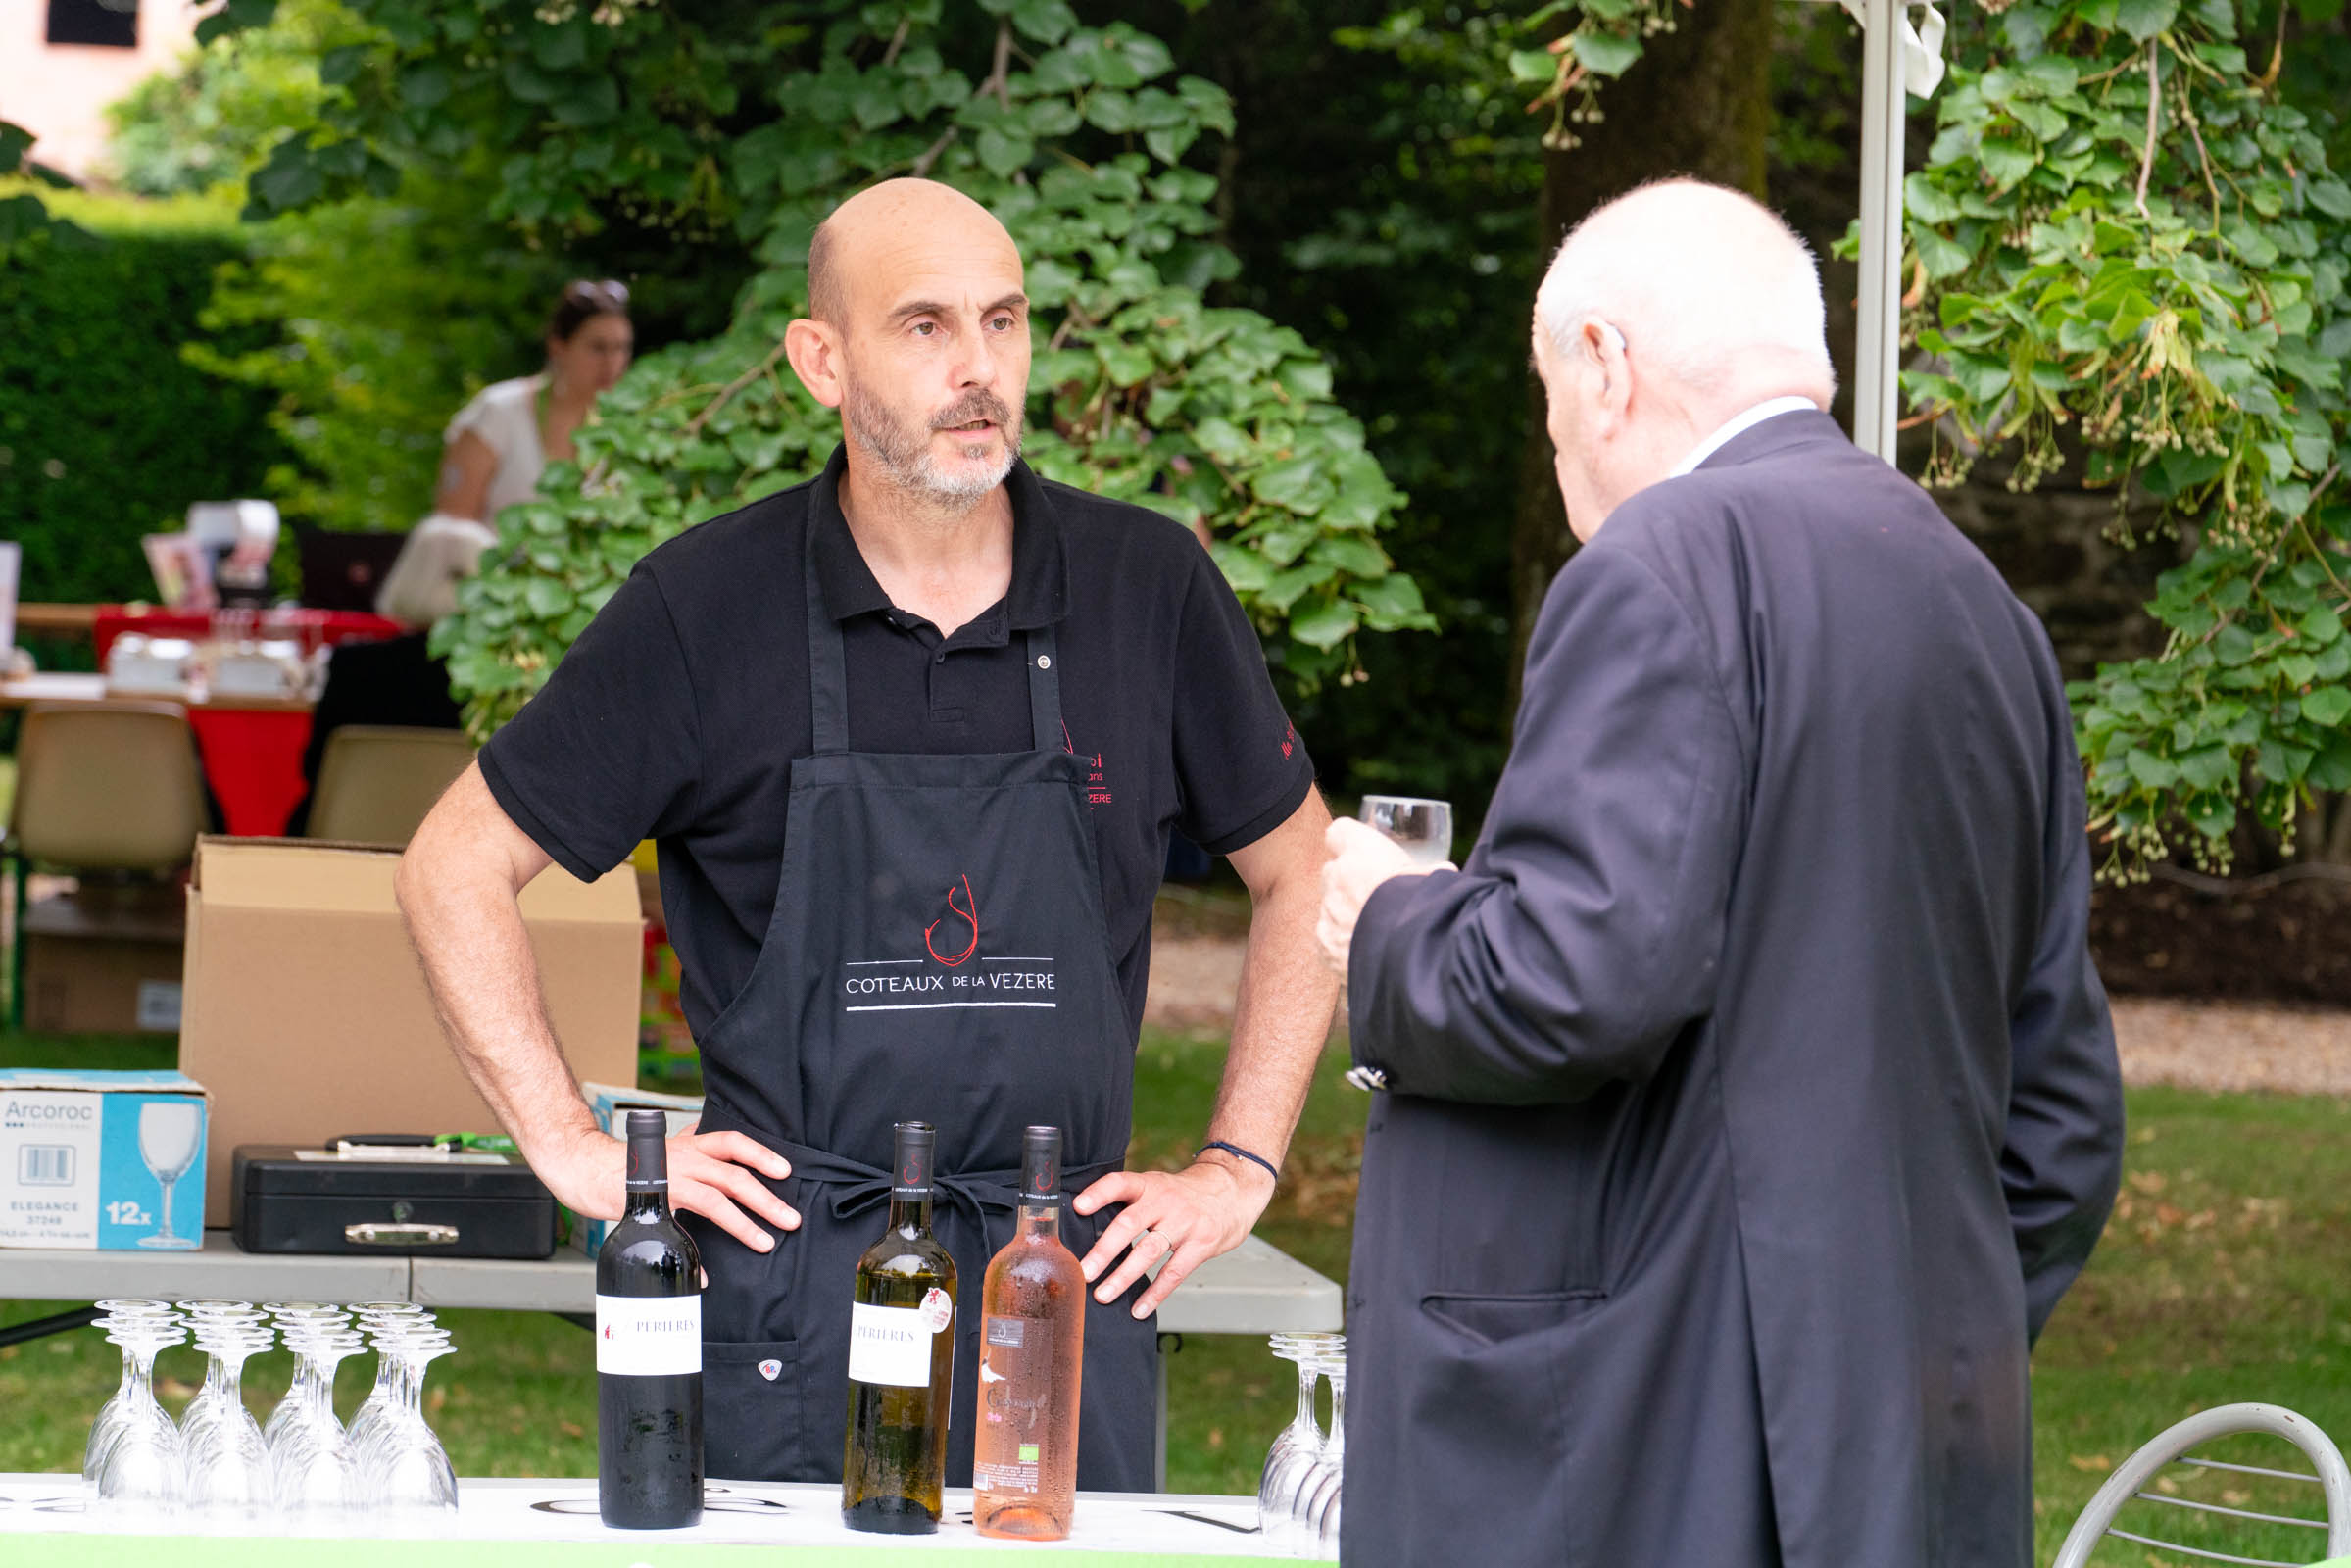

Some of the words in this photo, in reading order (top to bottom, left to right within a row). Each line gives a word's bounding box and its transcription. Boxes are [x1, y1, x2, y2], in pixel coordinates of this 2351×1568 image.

[846, 975, 944, 994] COTEAUX
[952, 976, 968, 987] DE
[971, 975, 986, 987] LA
[989, 973, 1056, 990] VEZERE
[5, 1101, 93, 1120] Arcoroc
[10, 1200, 78, 1212] ELEGANCE
[106, 1200, 152, 1225] 12x
